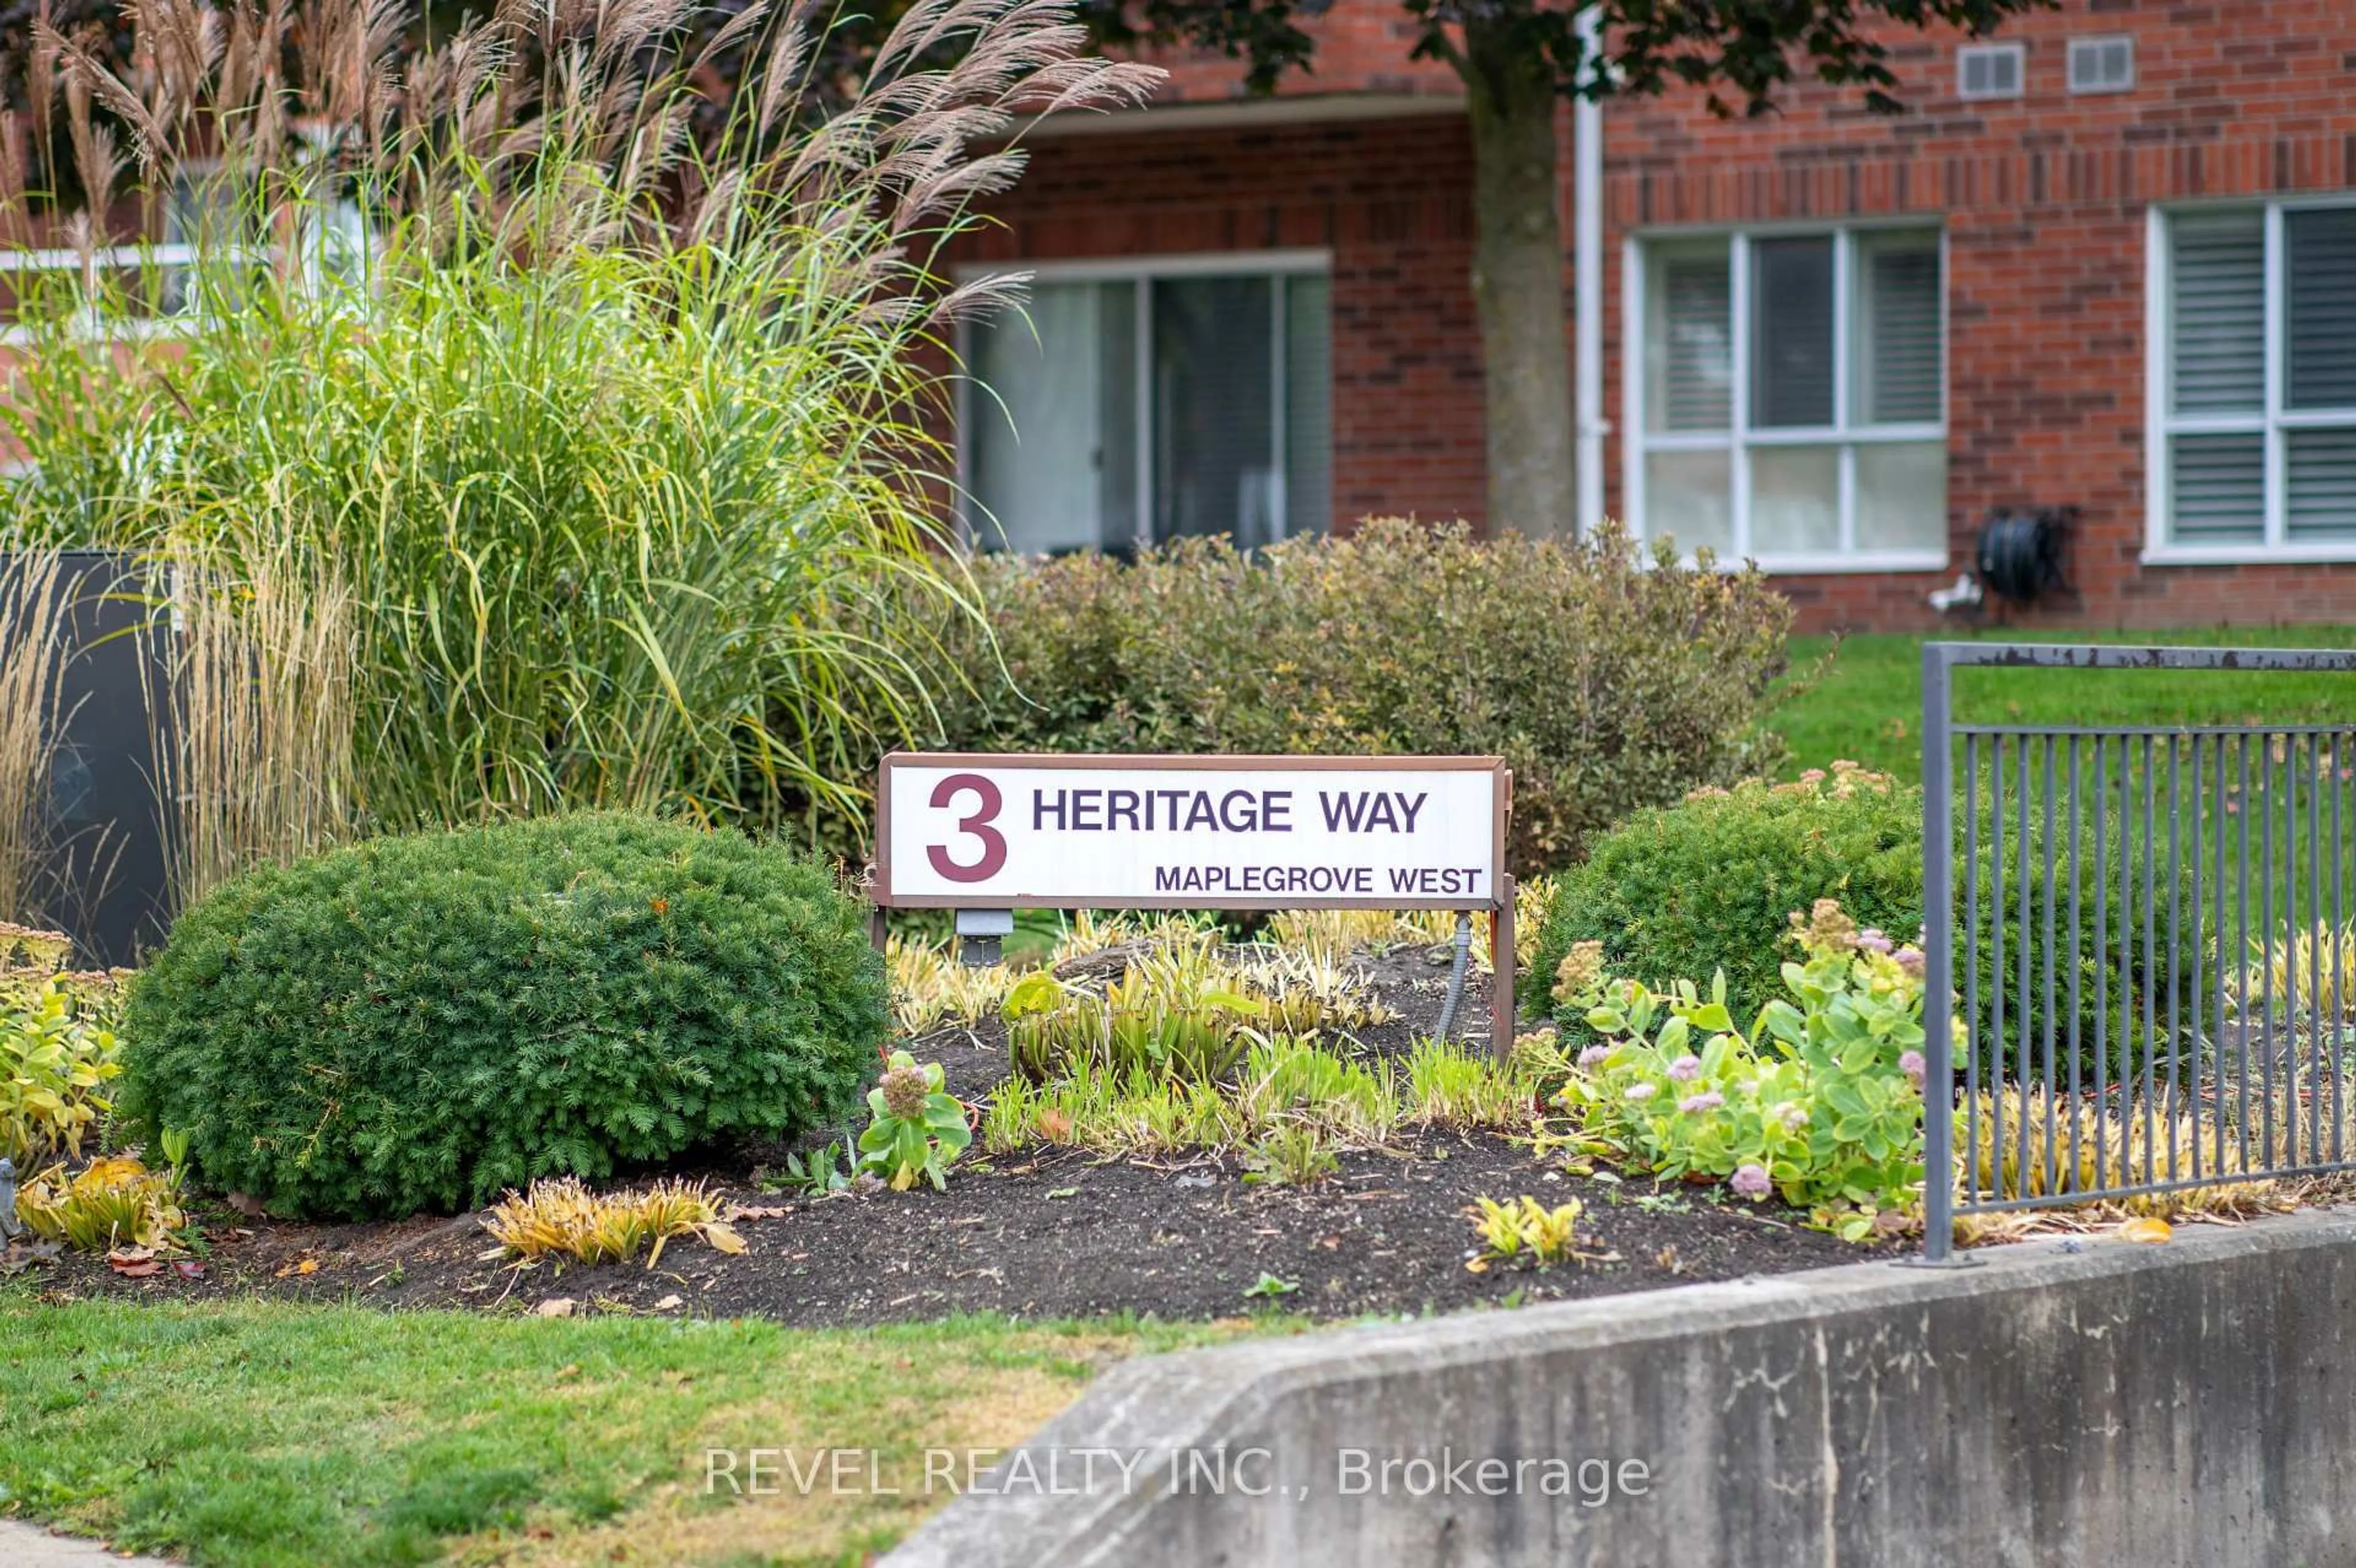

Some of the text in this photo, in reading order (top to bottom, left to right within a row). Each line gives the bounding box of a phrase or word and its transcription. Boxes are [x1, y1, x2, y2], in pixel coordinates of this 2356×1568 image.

[926, 773, 1428, 883] 3 HERITAGE WAY
[1155, 866, 1482, 894] MAPLEGROVE WEST
